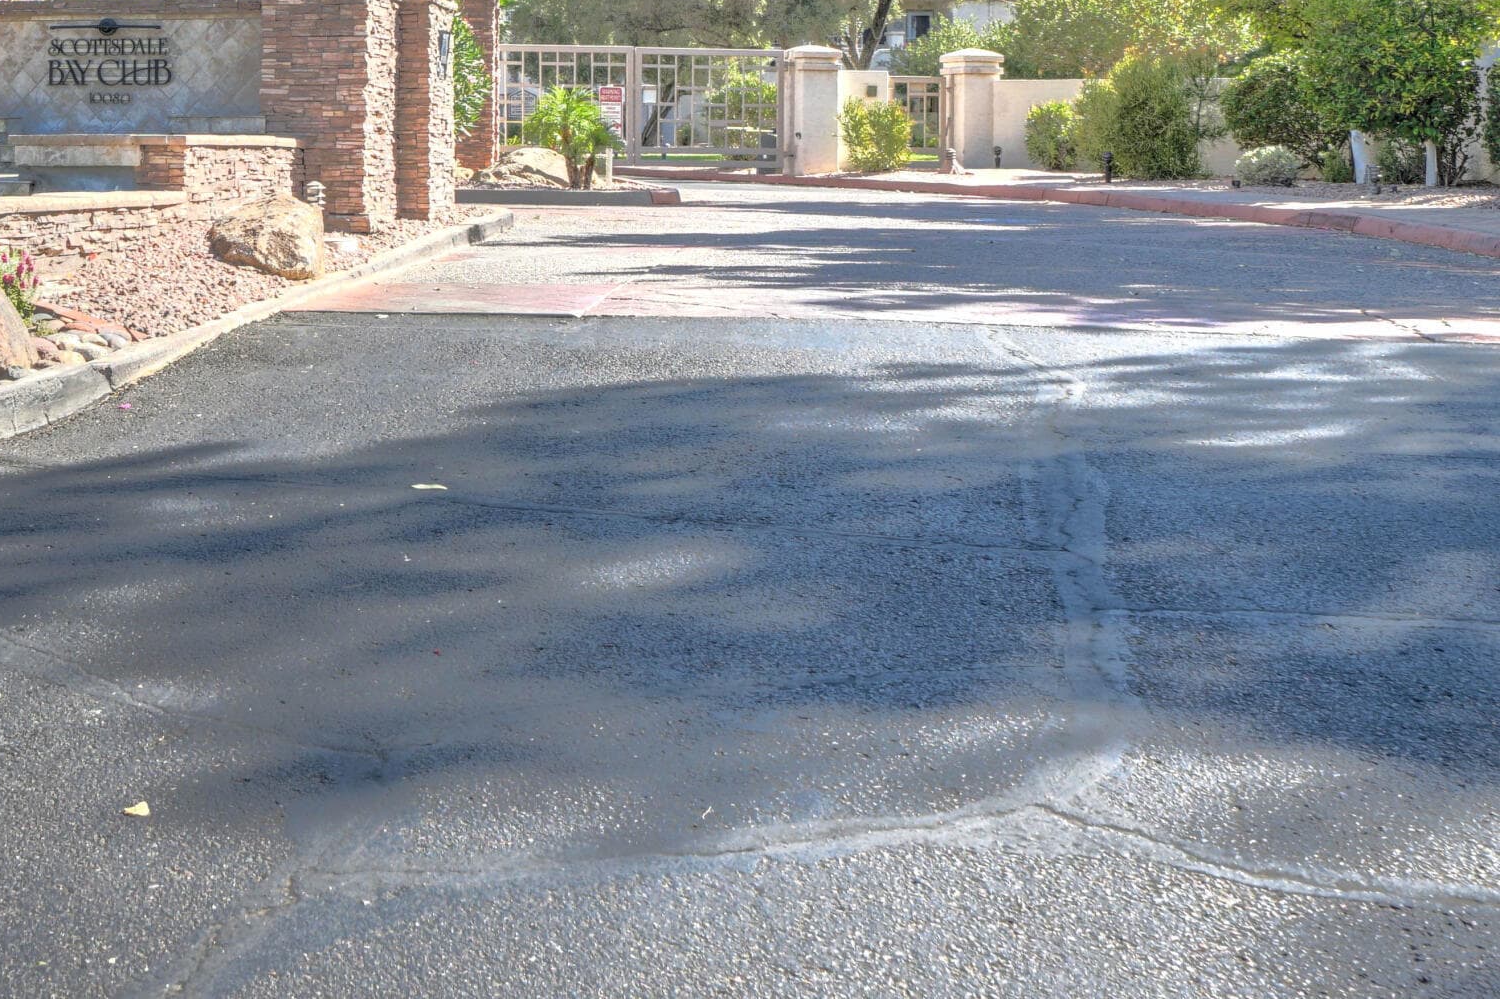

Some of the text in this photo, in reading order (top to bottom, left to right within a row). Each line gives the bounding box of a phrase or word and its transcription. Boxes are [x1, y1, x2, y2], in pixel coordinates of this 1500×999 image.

[49, 38, 169, 56] SCOTTSDALE
[49, 59, 172, 86] BAY CLUB
[90, 91, 131, 104] 10080
